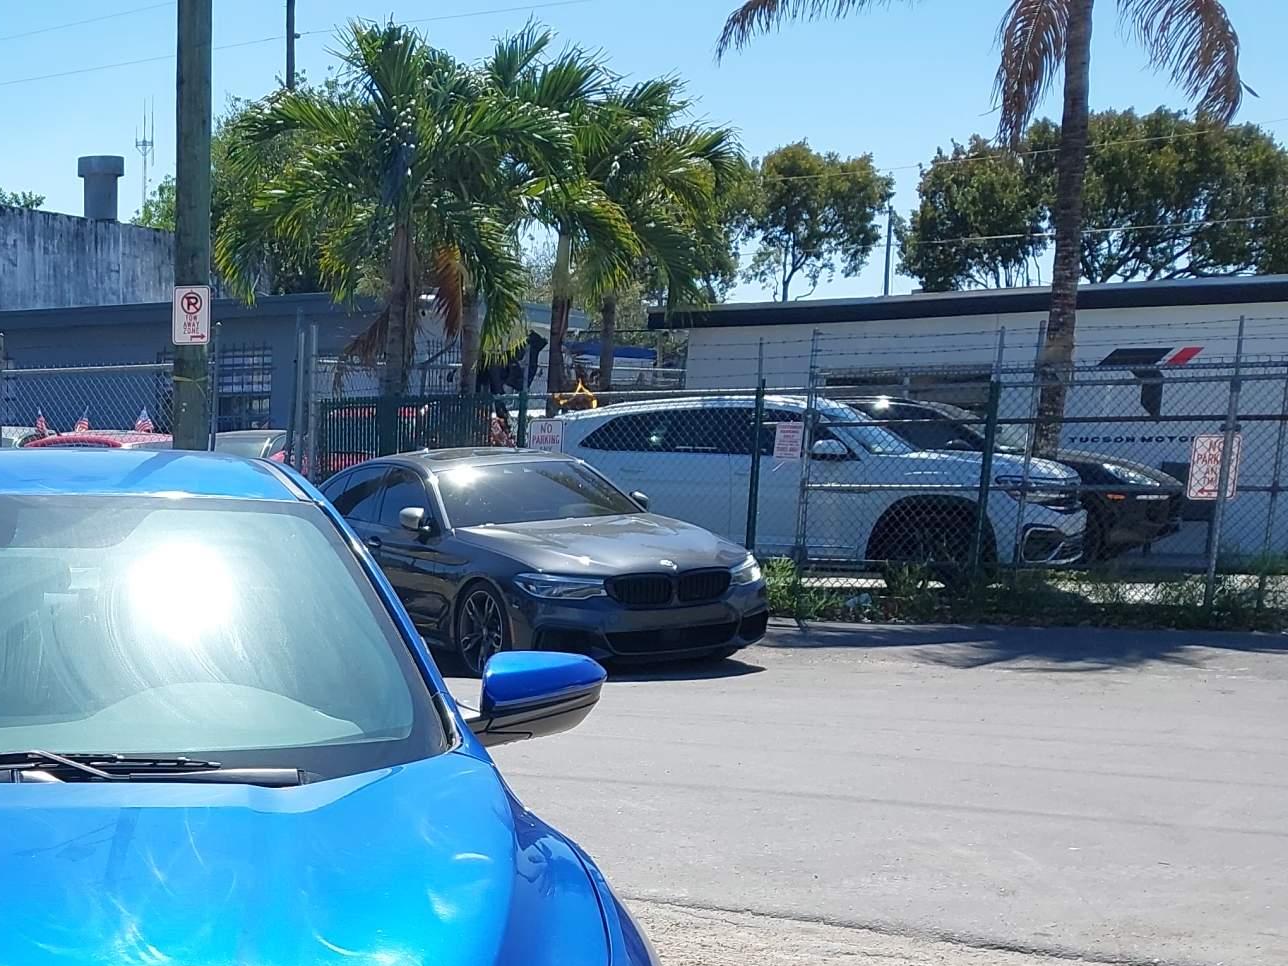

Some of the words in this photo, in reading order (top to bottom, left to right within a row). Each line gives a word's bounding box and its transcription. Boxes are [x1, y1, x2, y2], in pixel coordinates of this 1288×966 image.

[183, 327, 200, 335] ZONE
[540, 422, 553, 434] NO
[532, 434, 560, 446] PARKING
[1068, 436, 1135, 444] TUCSON
[1140, 435, 1195, 443] MOTO
